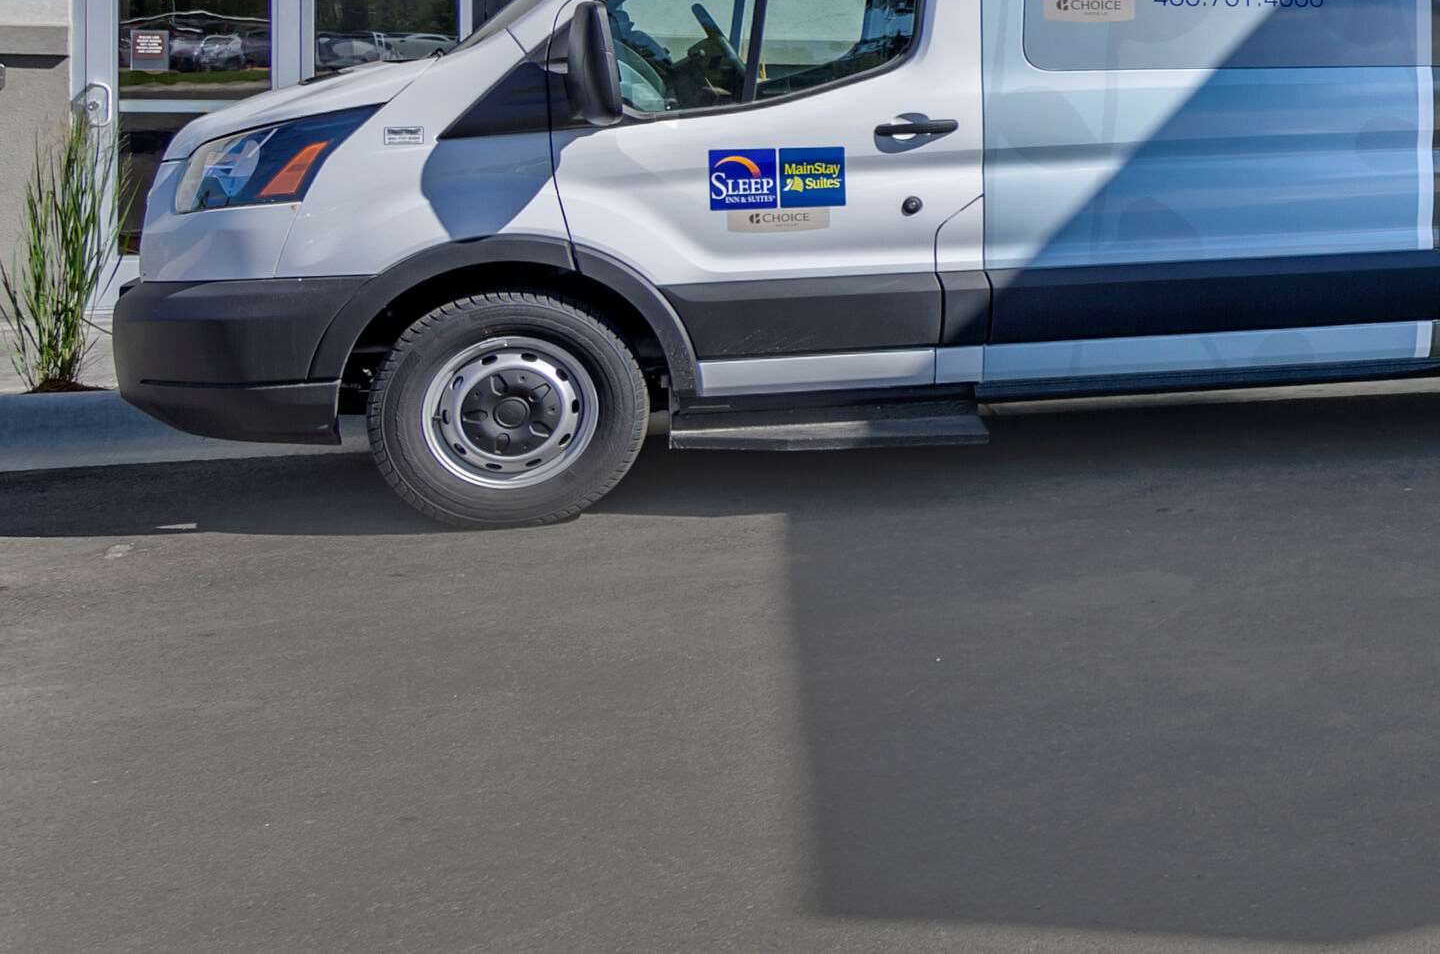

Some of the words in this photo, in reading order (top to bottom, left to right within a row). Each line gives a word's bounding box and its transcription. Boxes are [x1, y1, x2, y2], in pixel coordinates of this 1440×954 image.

[784, 162, 841, 178] MainStay
[711, 172, 774, 200] SLEEP
[805, 176, 841, 190] Suites
[762, 212, 811, 223] CHOICE
